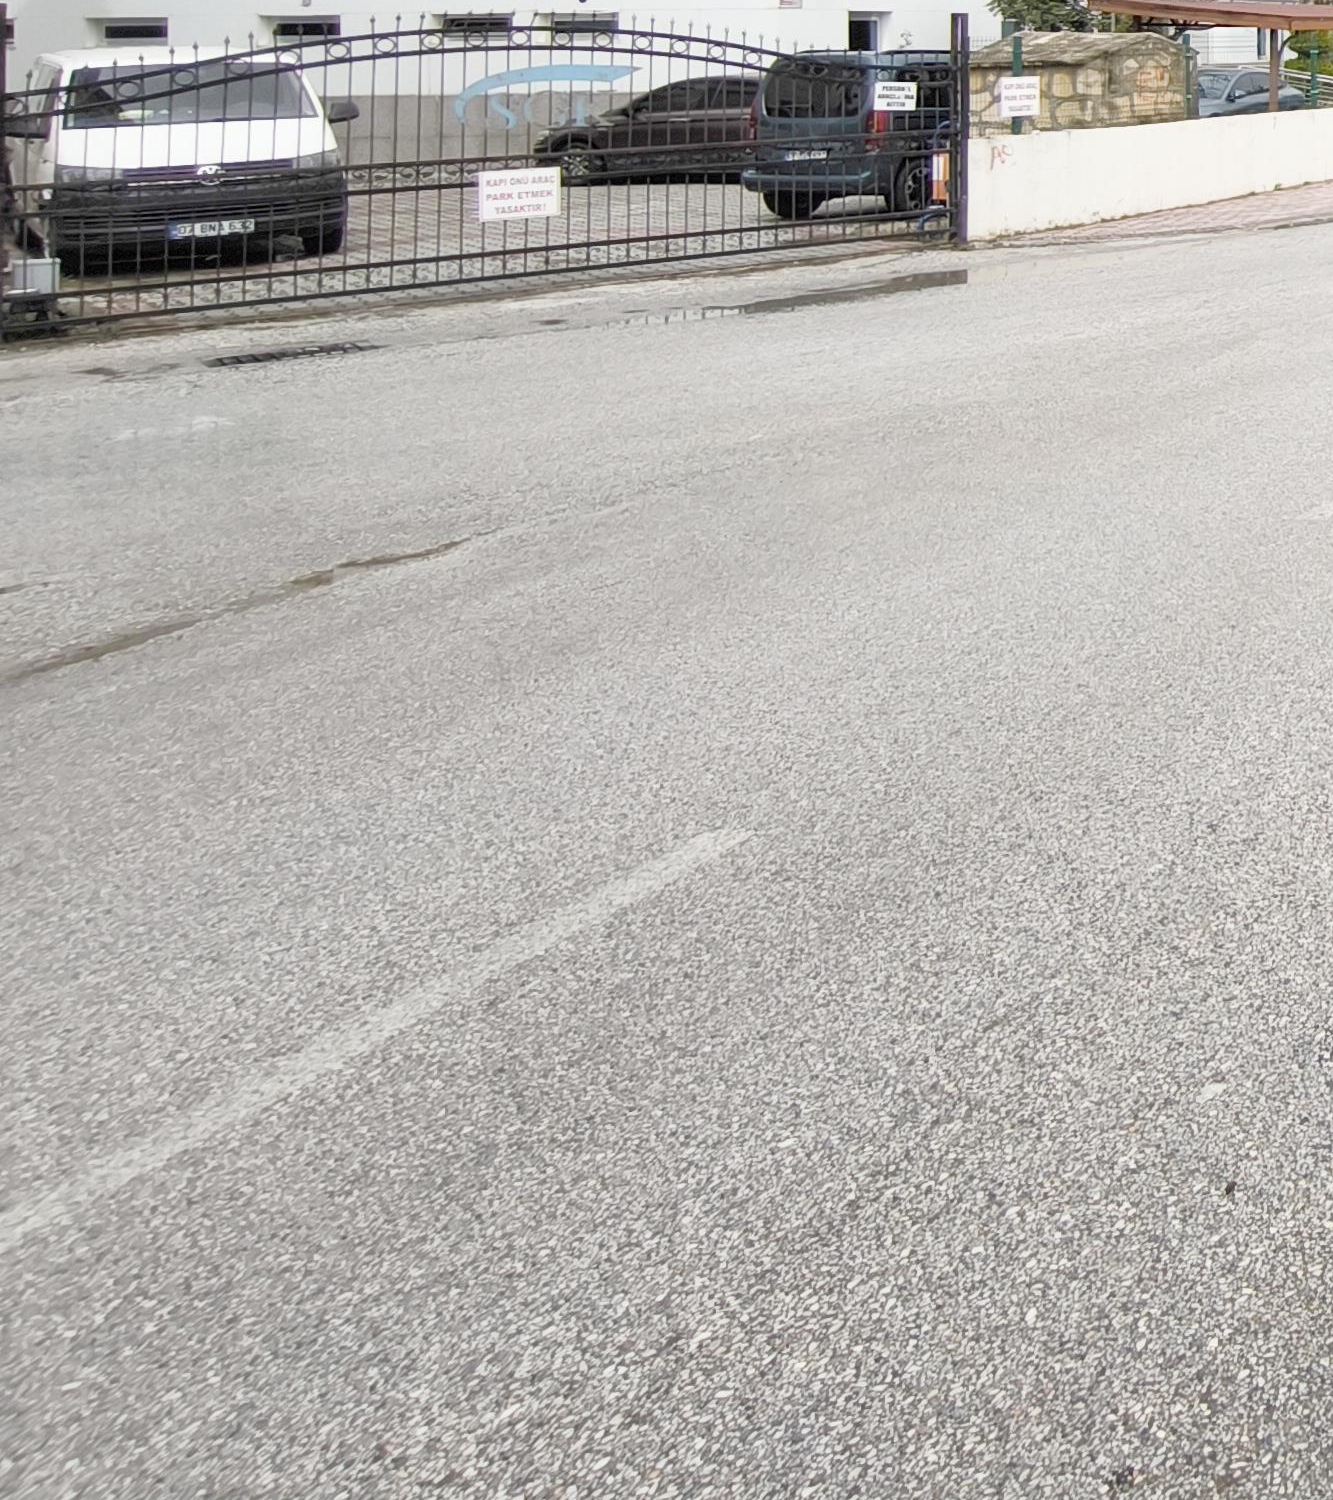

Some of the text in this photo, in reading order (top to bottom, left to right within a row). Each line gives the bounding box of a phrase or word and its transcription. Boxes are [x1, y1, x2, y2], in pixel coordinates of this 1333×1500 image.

[486, 178, 507, 187] KAPI
[486, 190, 554, 201] PARK ETMEK
